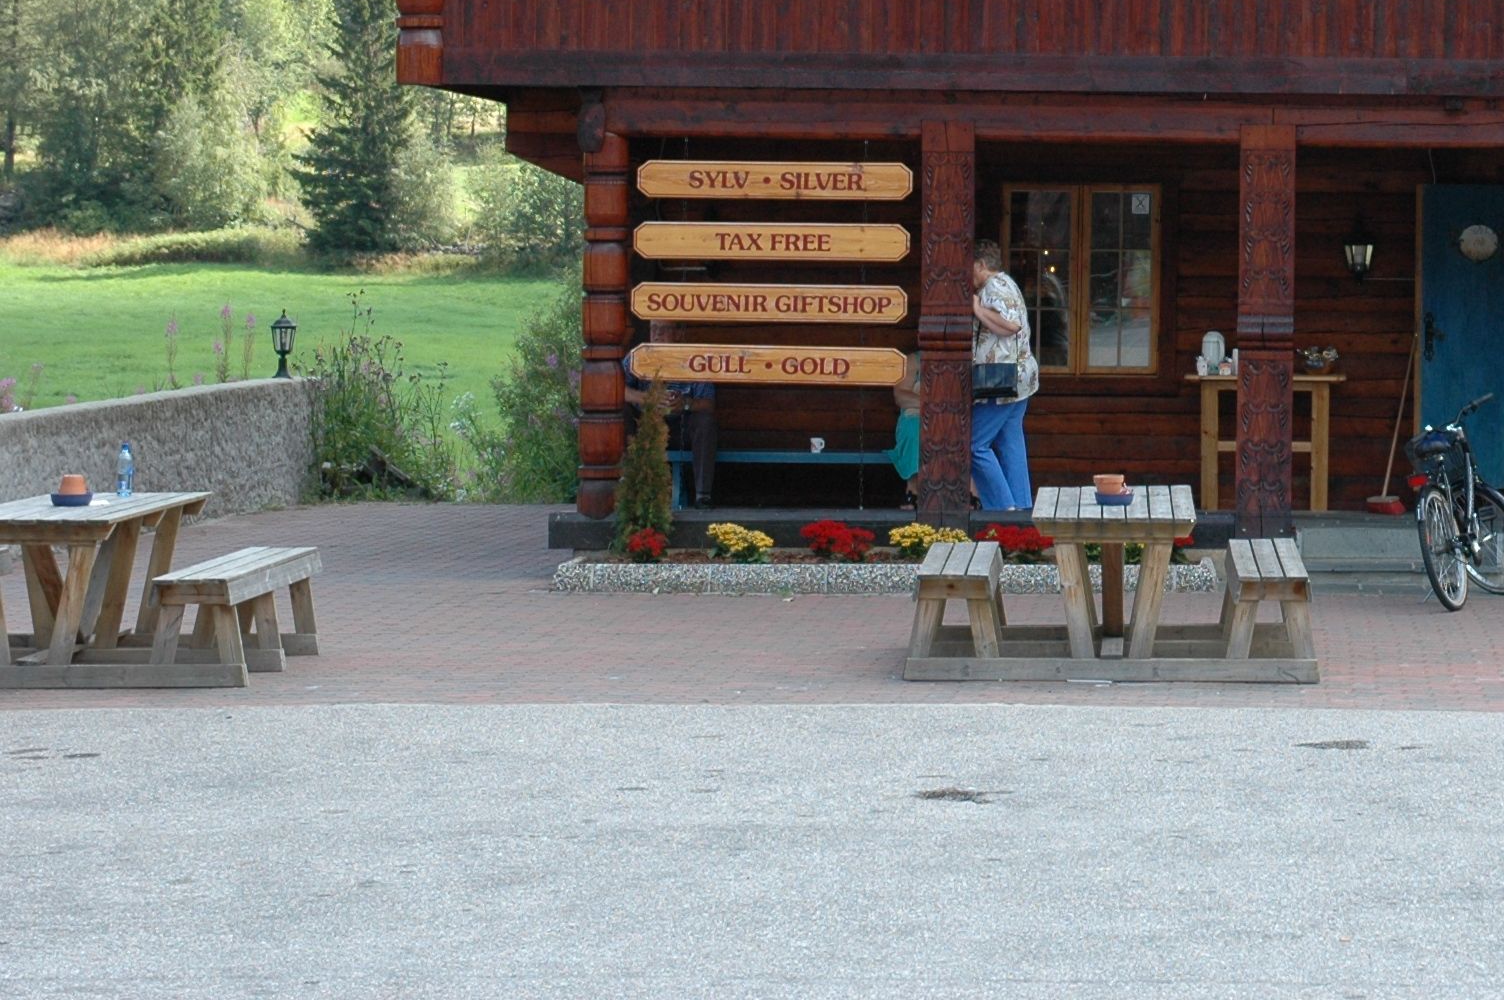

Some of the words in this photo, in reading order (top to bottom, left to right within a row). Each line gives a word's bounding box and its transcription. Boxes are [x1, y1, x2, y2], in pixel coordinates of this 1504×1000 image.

[688, 170, 750, 190] SYLV
[779, 171, 867, 192] SILVER
[715, 232, 763, 252] TAX
[769, 233, 832, 252] FREE
[646, 293, 768, 313] SOUVENIR
[774, 294, 892, 315] GIFTSHOP
[688, 354, 752, 374] GULL
[780, 356, 851, 376] GOLD
